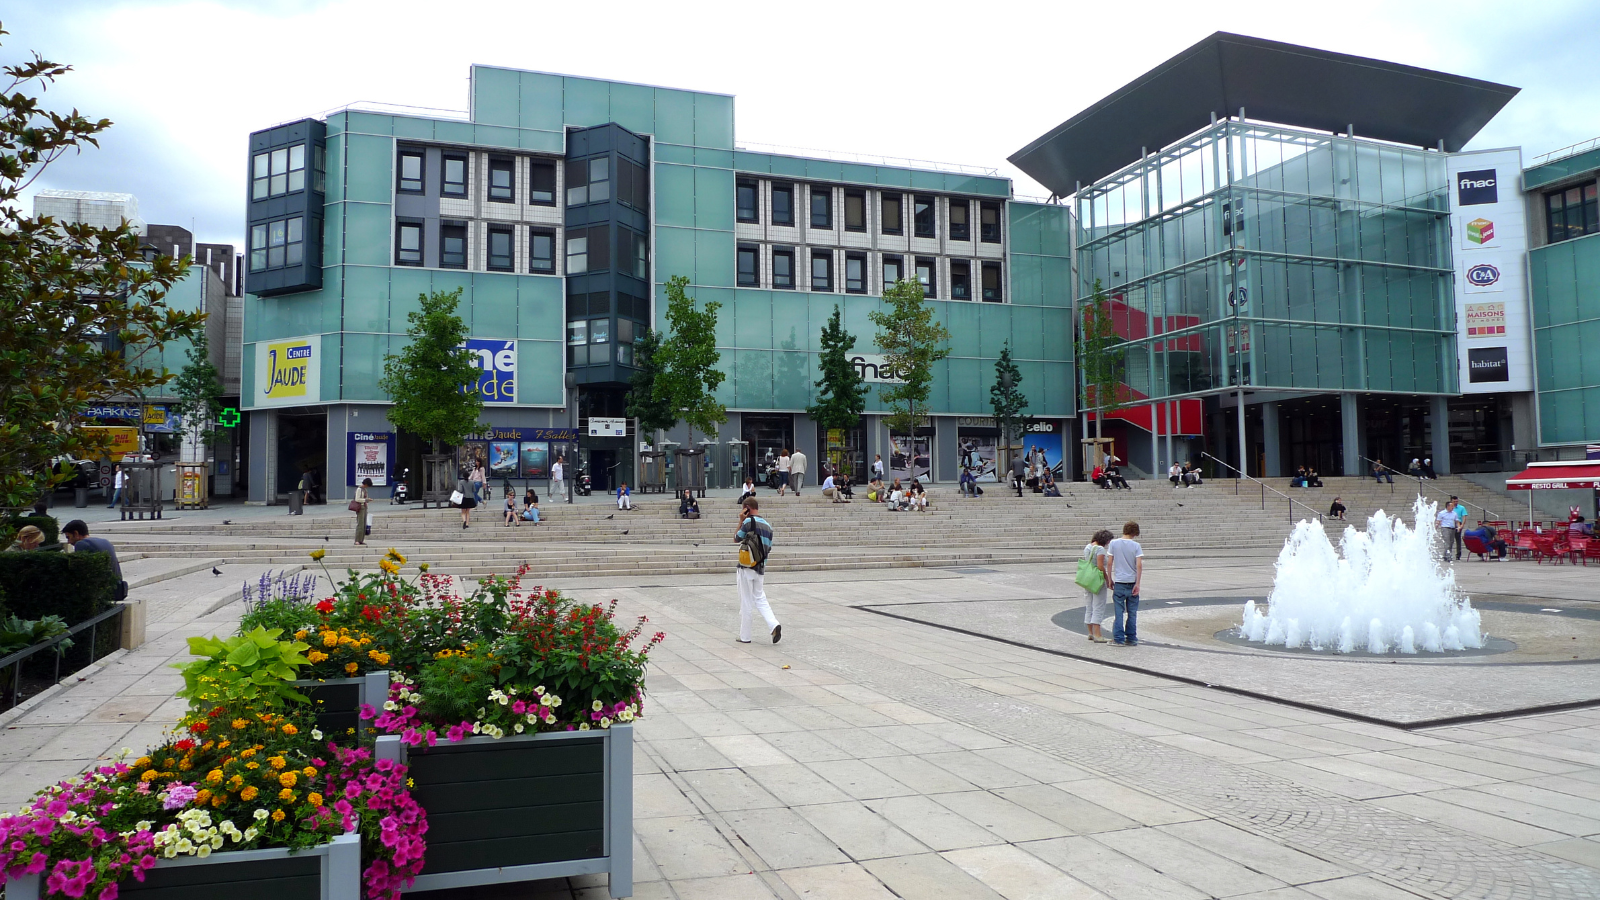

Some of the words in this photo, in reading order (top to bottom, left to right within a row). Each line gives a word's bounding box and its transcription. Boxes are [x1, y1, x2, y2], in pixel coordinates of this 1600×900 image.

[1460, 179, 1496, 189] fnac
[1472, 269, 1495, 281] C&A
[1467, 310, 1505, 319] MAISONS
[287, 348, 310, 359] CENTRE
[1471, 360, 1502, 369] habitat
[263, 349, 307, 395] JAUDE
[87, 406, 141, 417] PARKING
[354, 433, 374, 441] Ciné
[493, 428, 522, 440] Jaude
[535, 429, 544, 439] 7
